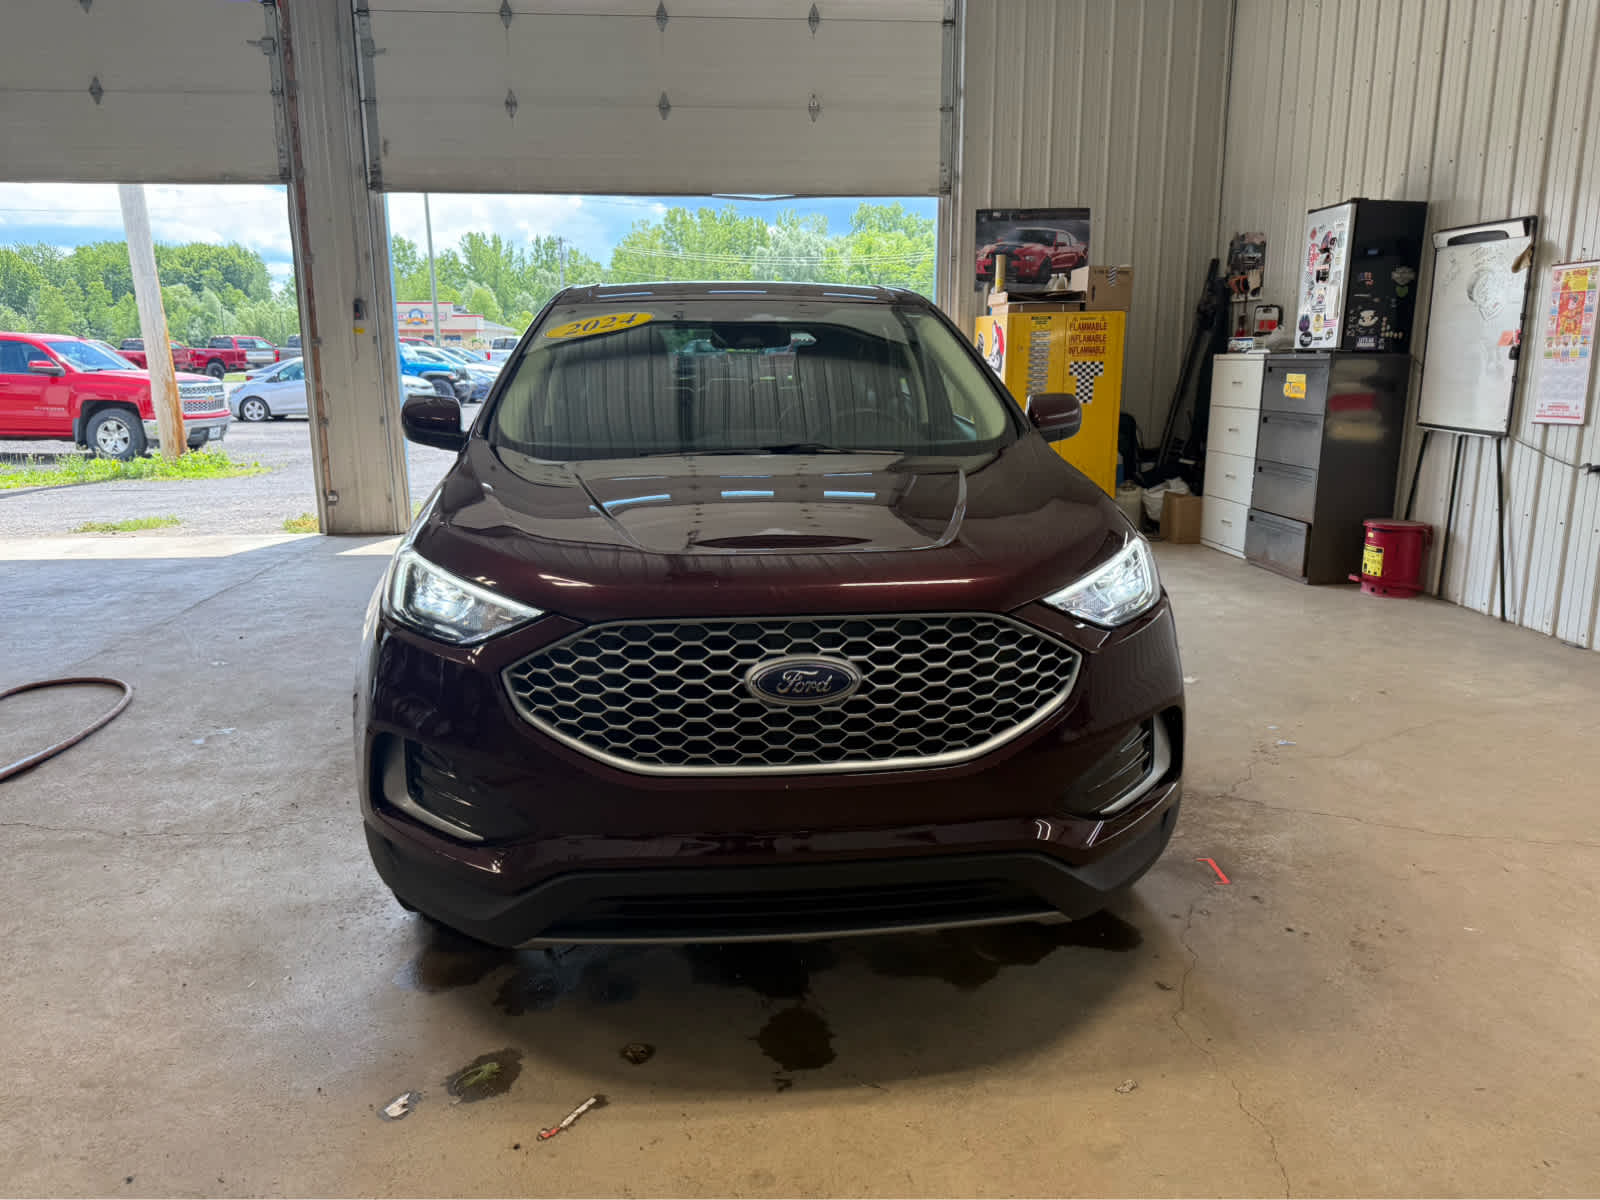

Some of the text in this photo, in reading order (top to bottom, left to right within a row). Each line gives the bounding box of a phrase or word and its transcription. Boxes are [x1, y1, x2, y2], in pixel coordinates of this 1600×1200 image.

[565, 313, 638, 335] 2024
[1069, 321, 1108, 331] FLAMMABLE
[776, 670, 833, 694] Ford
